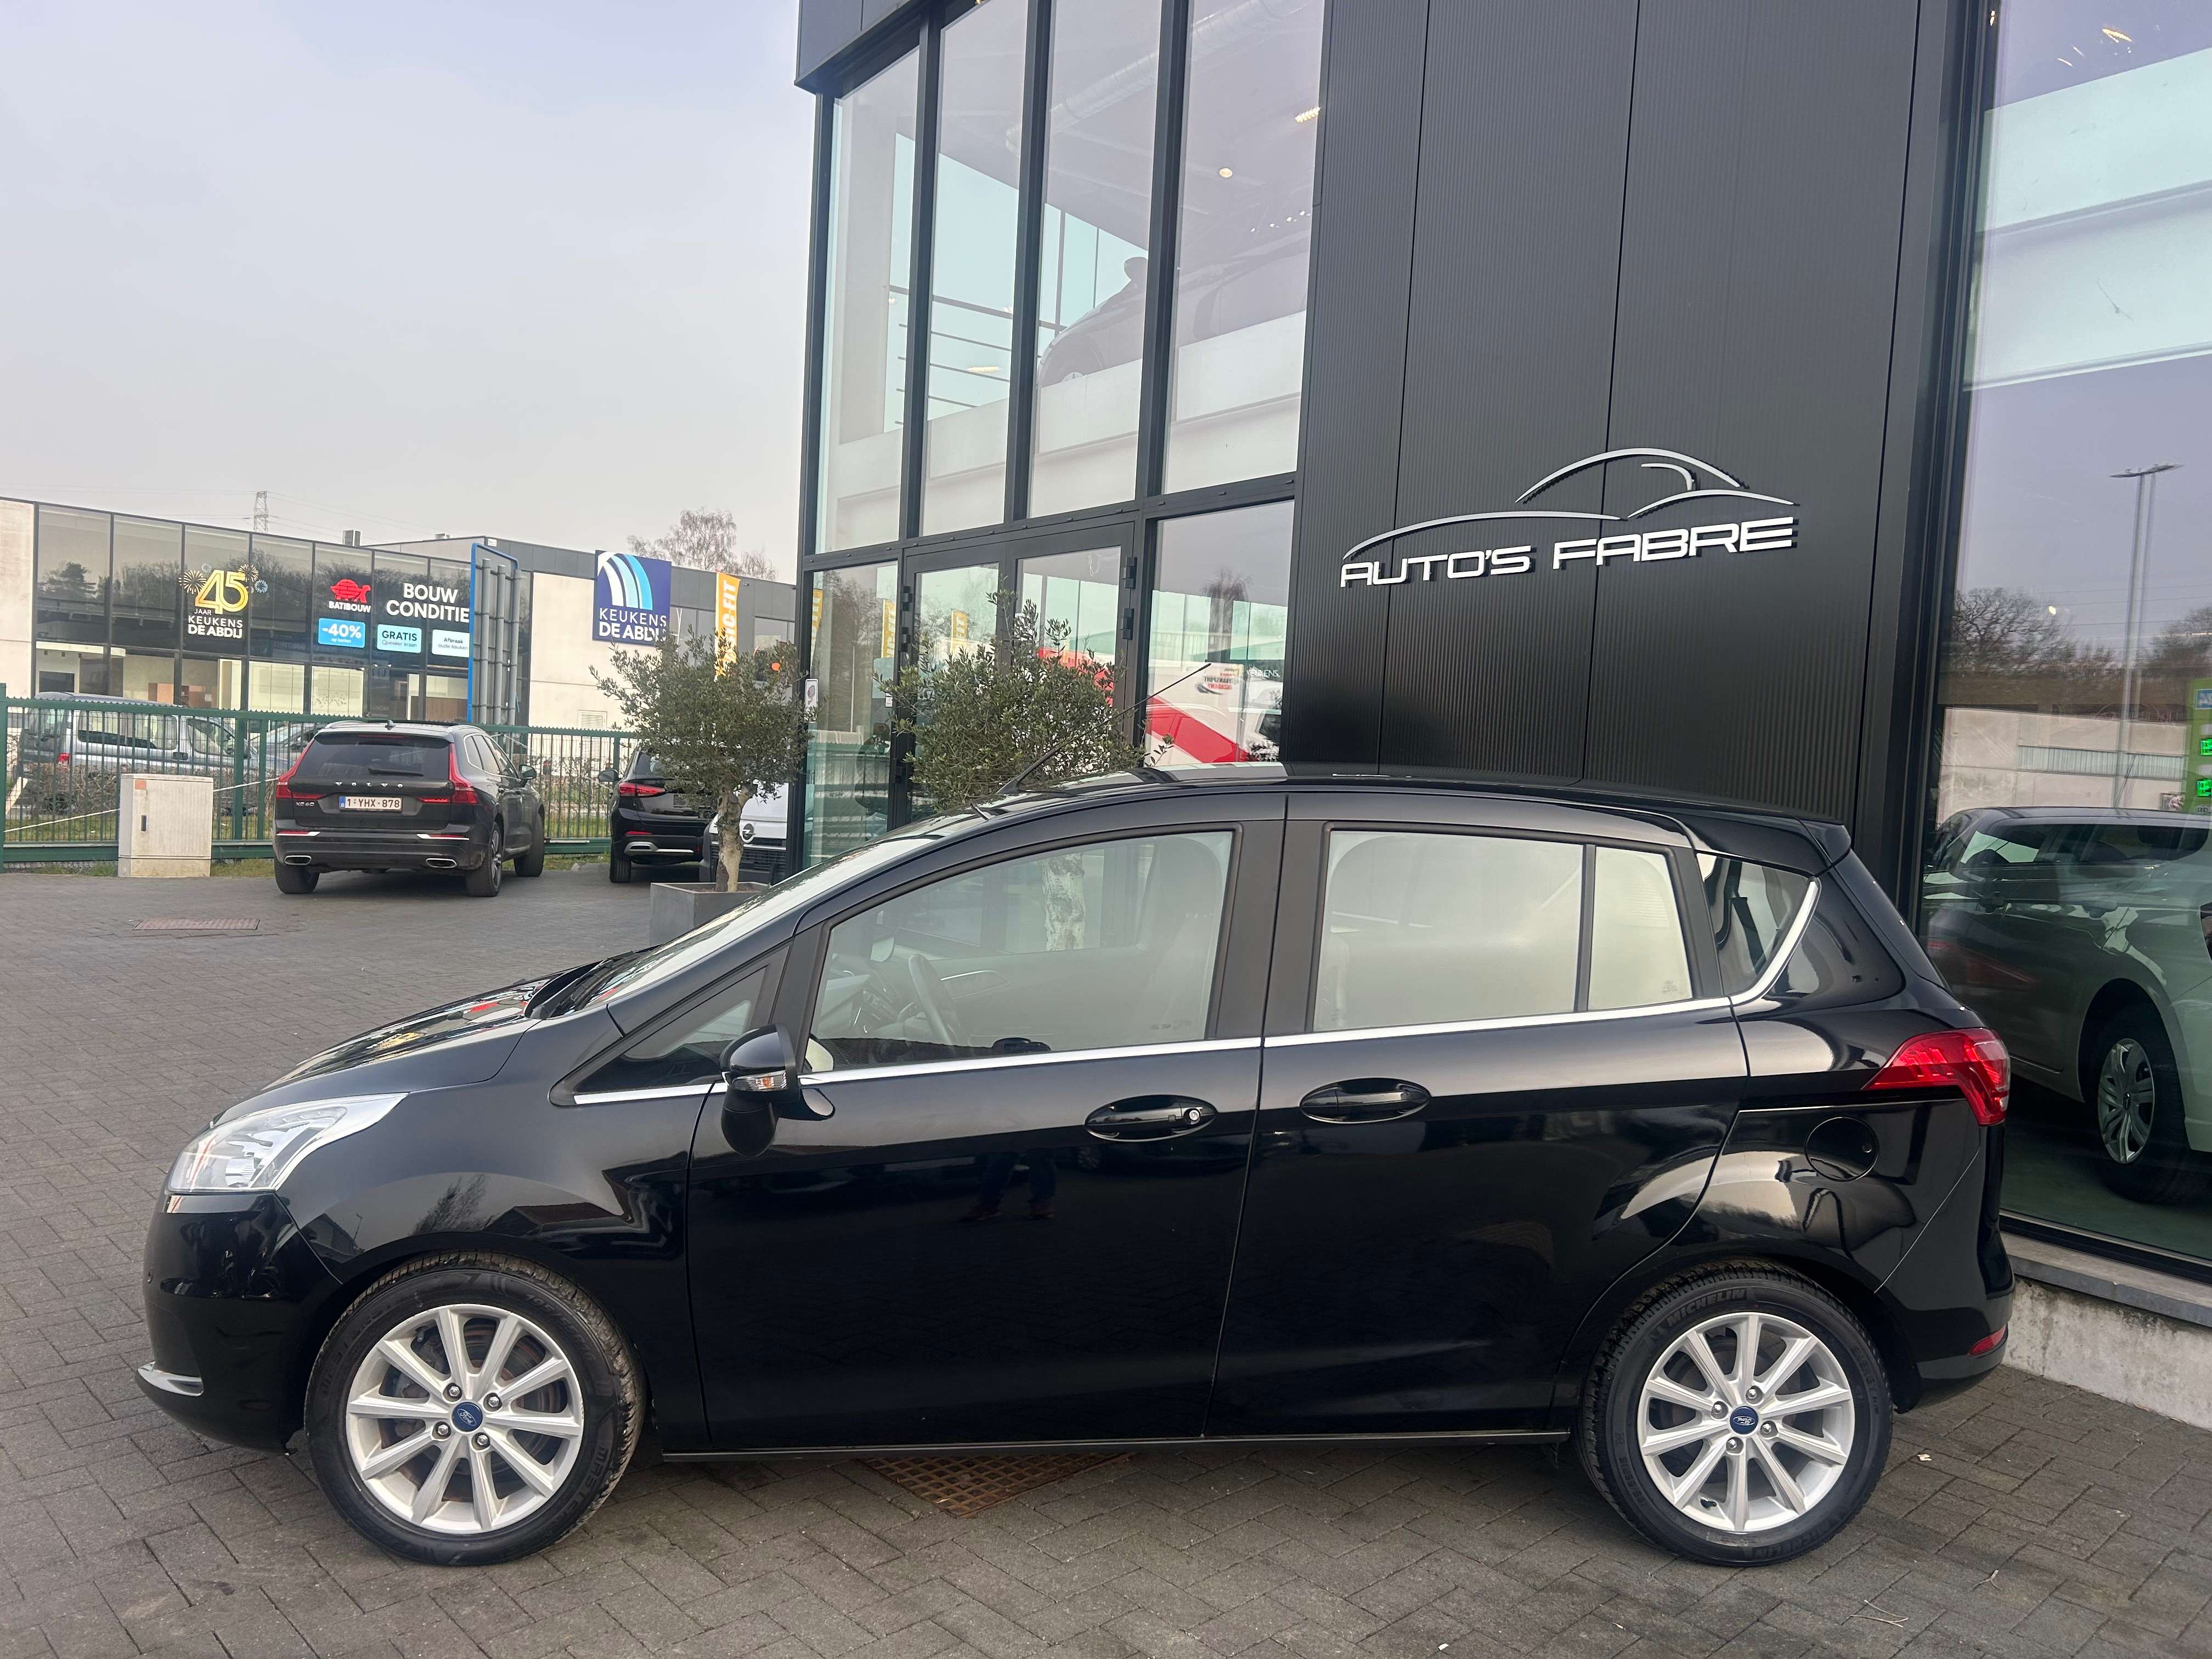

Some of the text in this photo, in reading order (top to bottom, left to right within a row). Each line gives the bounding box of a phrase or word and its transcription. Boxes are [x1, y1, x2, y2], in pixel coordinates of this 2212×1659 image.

[1340, 516, 1795, 588] AUTO'S FABRE
[195, 569, 249, 615] 45
[403, 583, 459, 604] BOUW
[329, 601, 371, 613] BATIBOUW
[188, 615, 244, 629] KEUKENS
[599, 607, 667, 628] KEUKENS
[188, 624, 243, 639] DE ABDIJ
[322, 623, 363, 639] -40%
[381, 630, 417, 642] GRATIS
[599, 621, 621, 639] DE
[1666, 1288, 1747, 1328] MICHELIN
